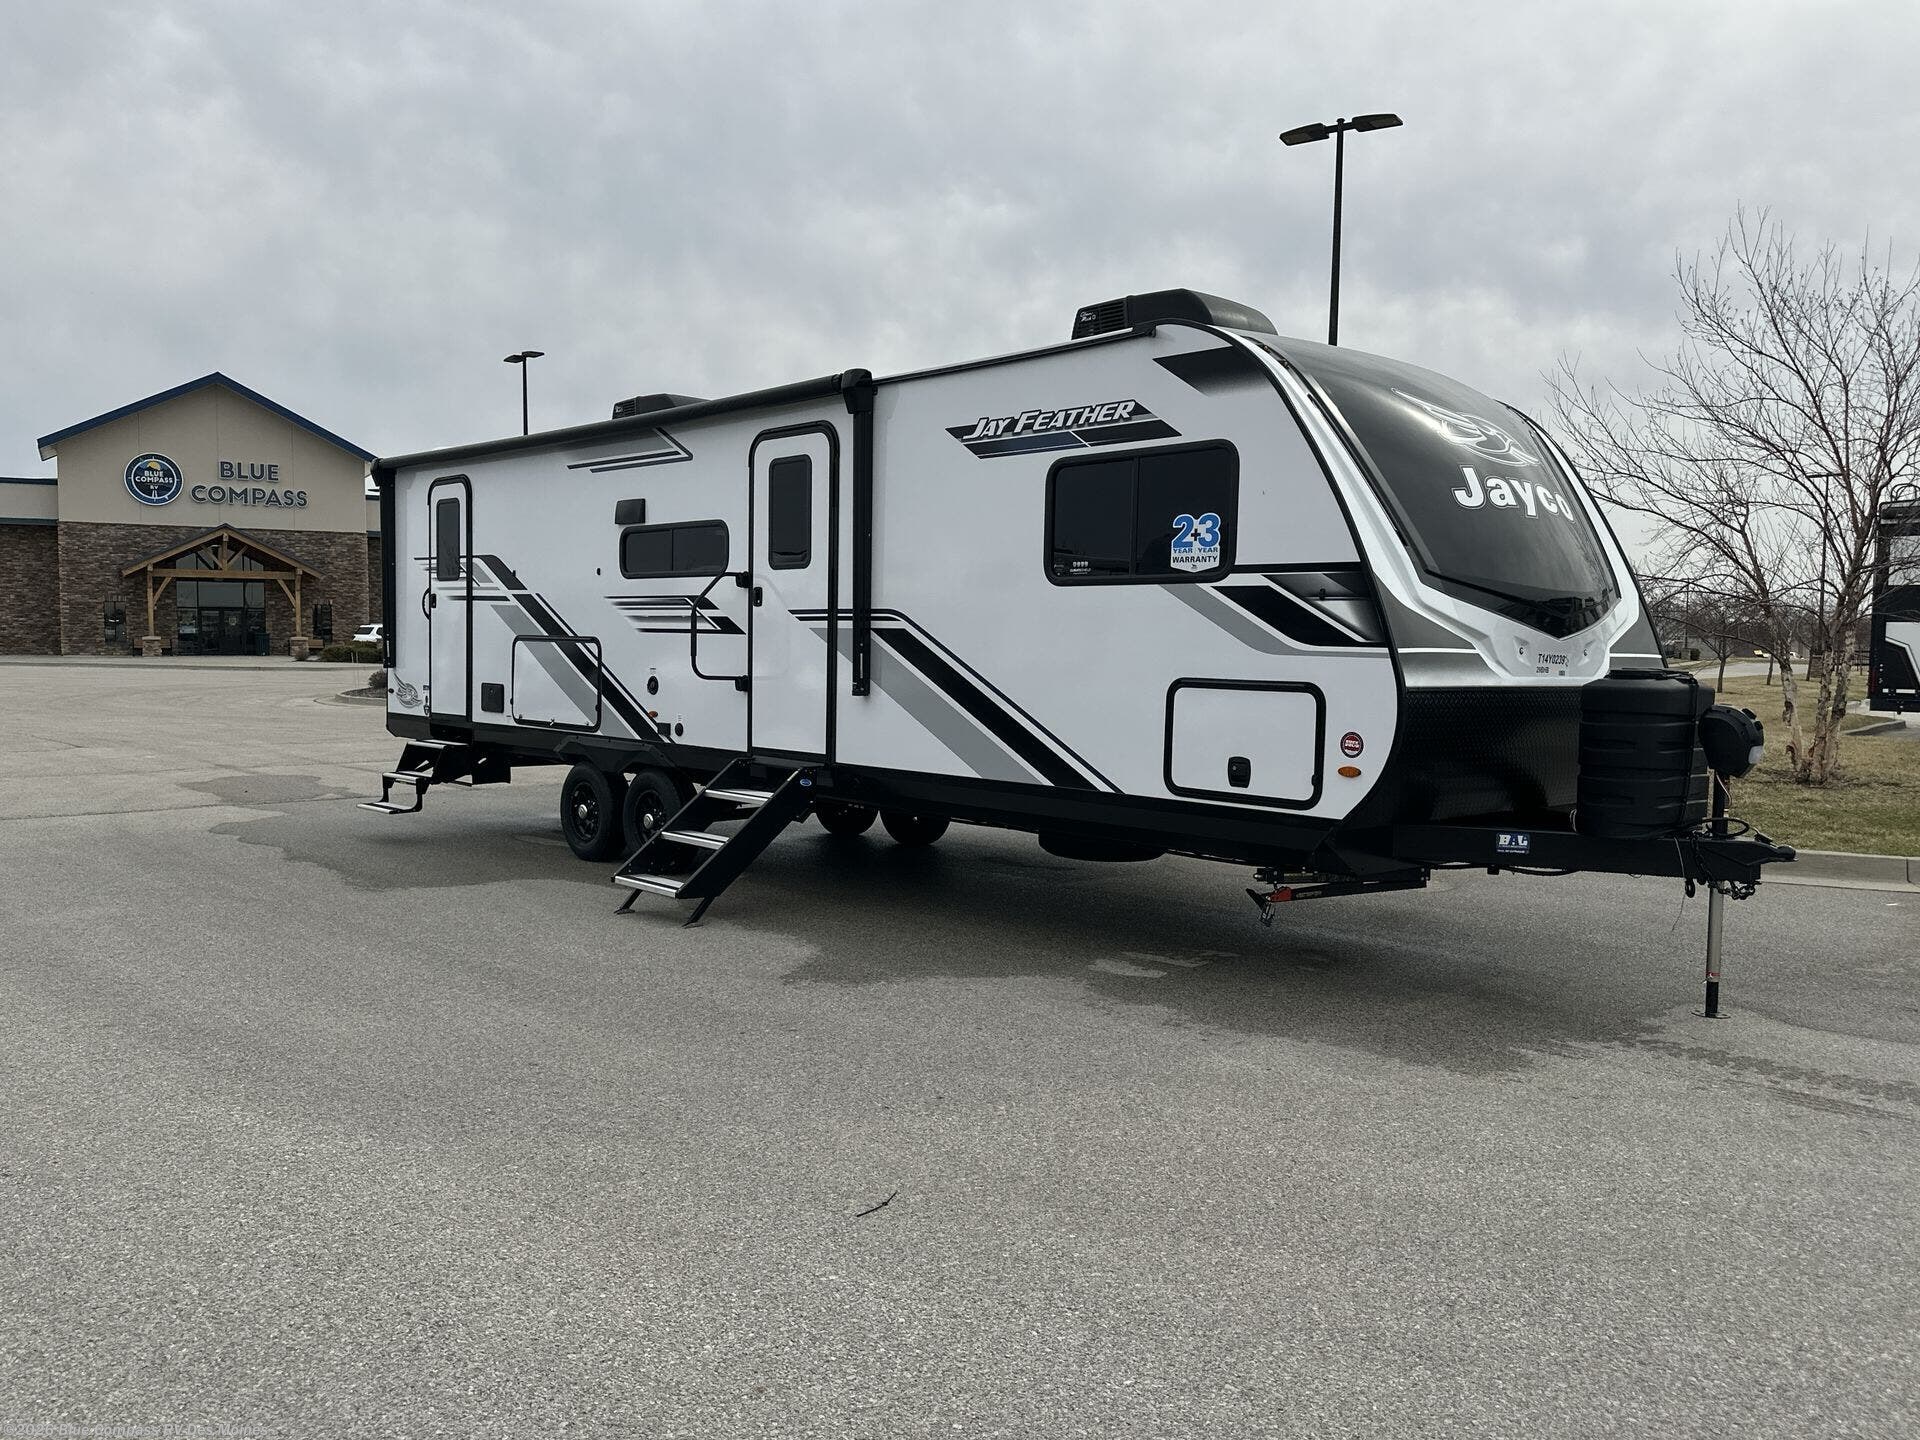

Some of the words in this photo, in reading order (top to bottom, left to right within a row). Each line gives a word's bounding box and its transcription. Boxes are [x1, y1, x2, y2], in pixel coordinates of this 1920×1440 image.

[963, 418, 1011, 440] JAY
[1013, 401, 1136, 433] FEATHER
[135, 476, 173, 484] COMPASS
[219, 460, 281, 482] BLUE
[190, 484, 309, 508] COMPASS
[1452, 465, 1575, 522] Jayco
[1172, 555, 1218, 564] WARRANTY
